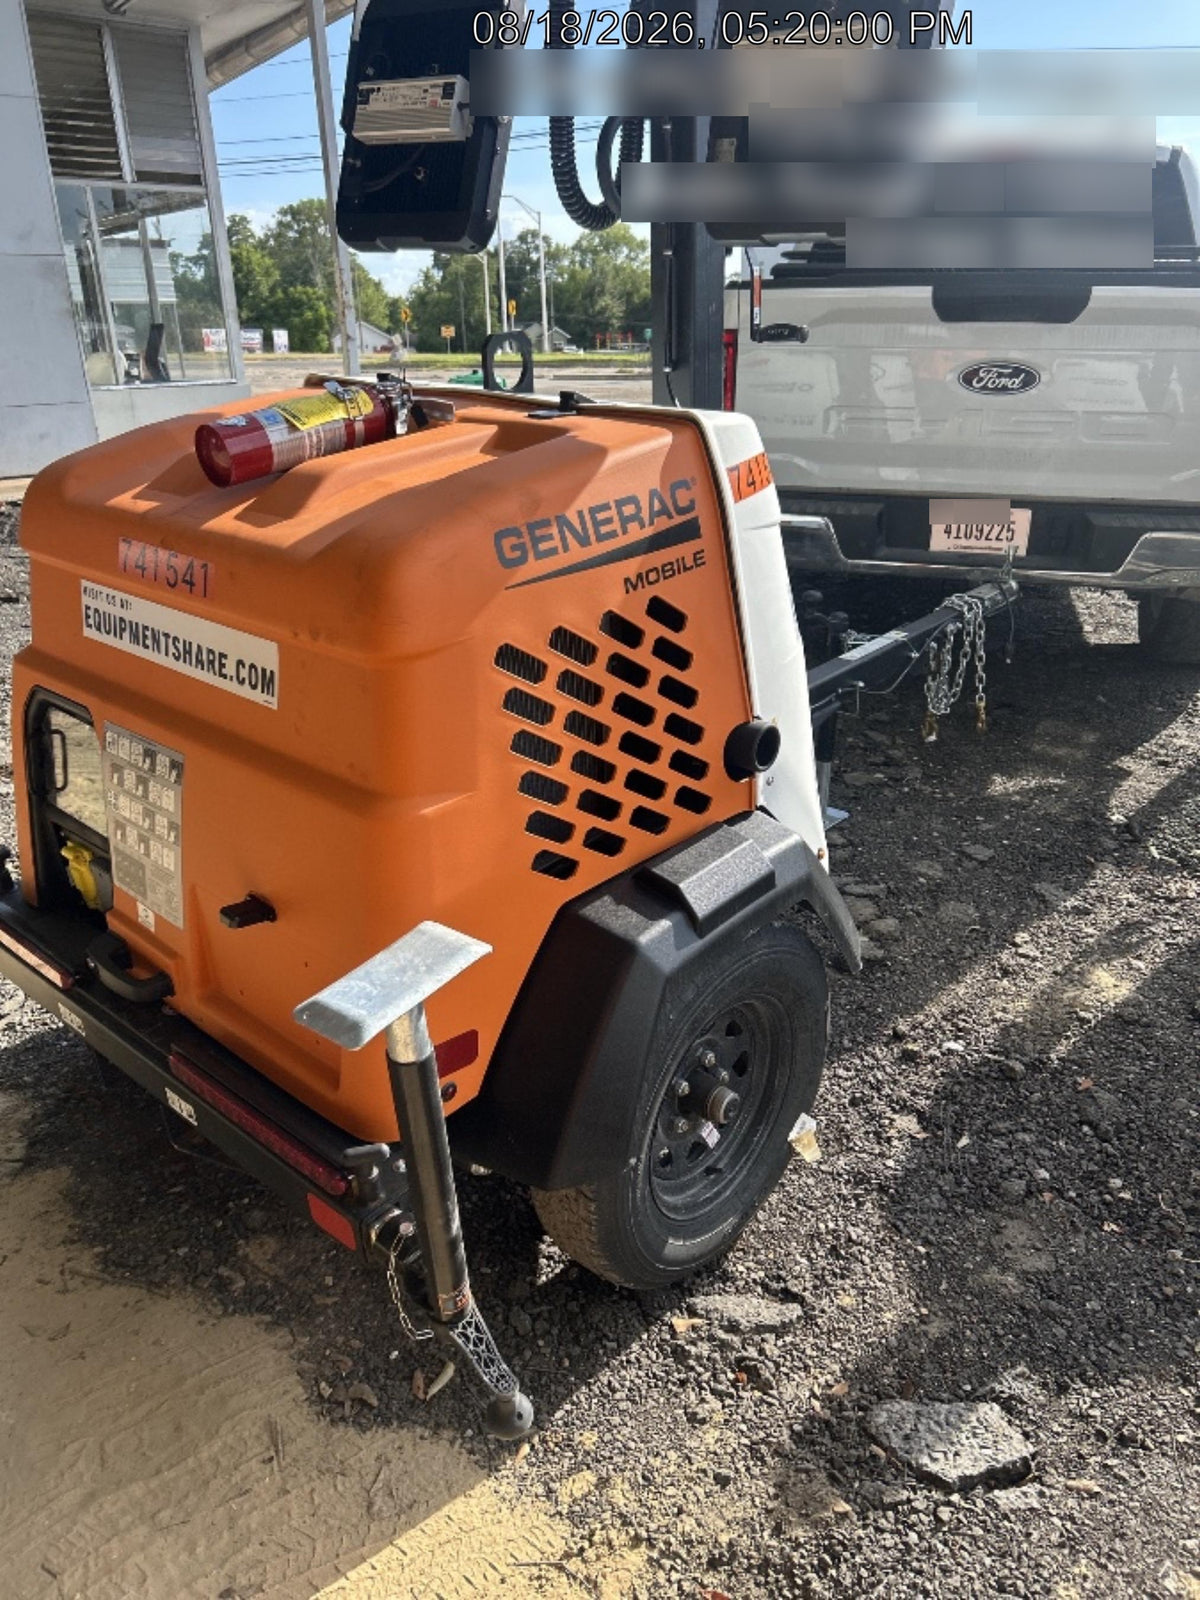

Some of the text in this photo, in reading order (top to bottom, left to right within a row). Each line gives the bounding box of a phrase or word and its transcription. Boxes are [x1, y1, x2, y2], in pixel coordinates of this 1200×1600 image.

[972, 367, 1025, 389] Ford
[493, 478, 697, 570] GENERAC
[121, 538, 209, 598] 741541
[623, 549, 707, 595] MOBILE
[84, 604, 276, 698] EQUIPMENTSHARE.COM
